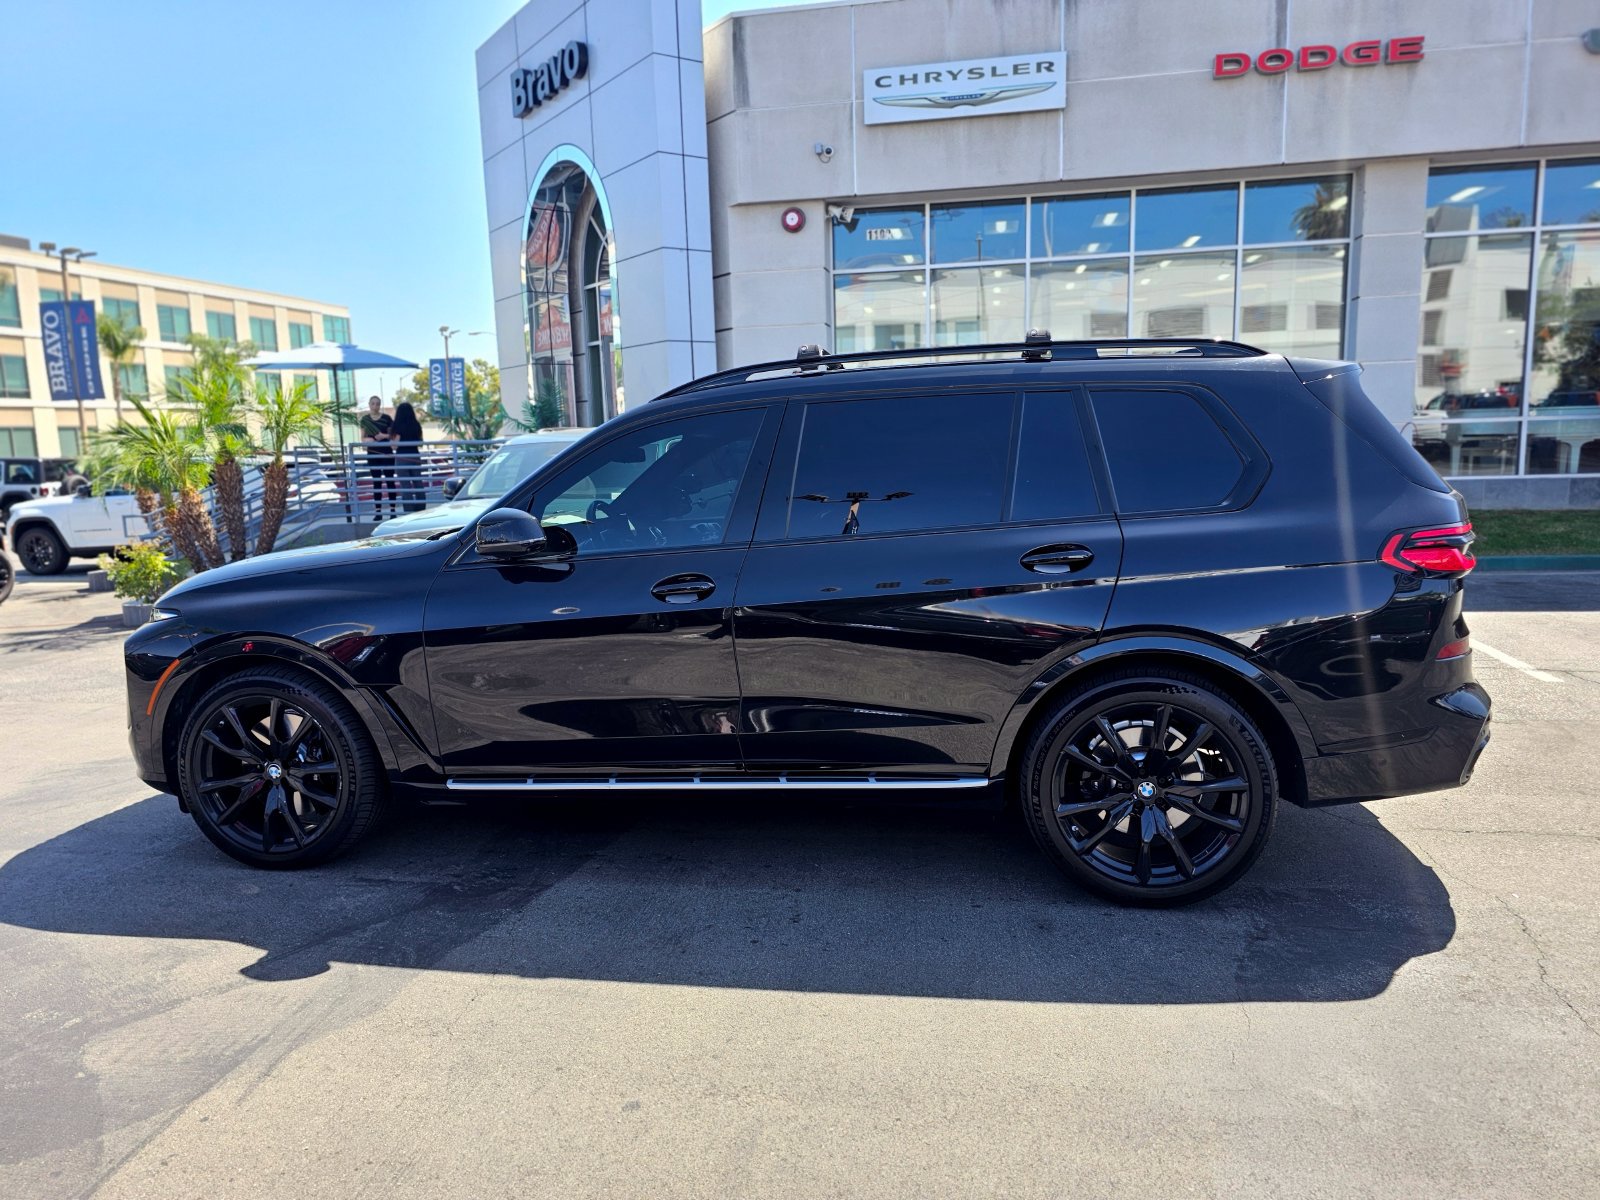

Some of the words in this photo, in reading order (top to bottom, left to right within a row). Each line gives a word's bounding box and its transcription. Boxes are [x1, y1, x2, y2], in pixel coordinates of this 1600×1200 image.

[510, 40, 588, 118] Bravo
[875, 61, 1055, 88] CHRYSLER
[1213, 36, 1425, 80] DODGE
[43, 310, 67, 393] BRAVO
